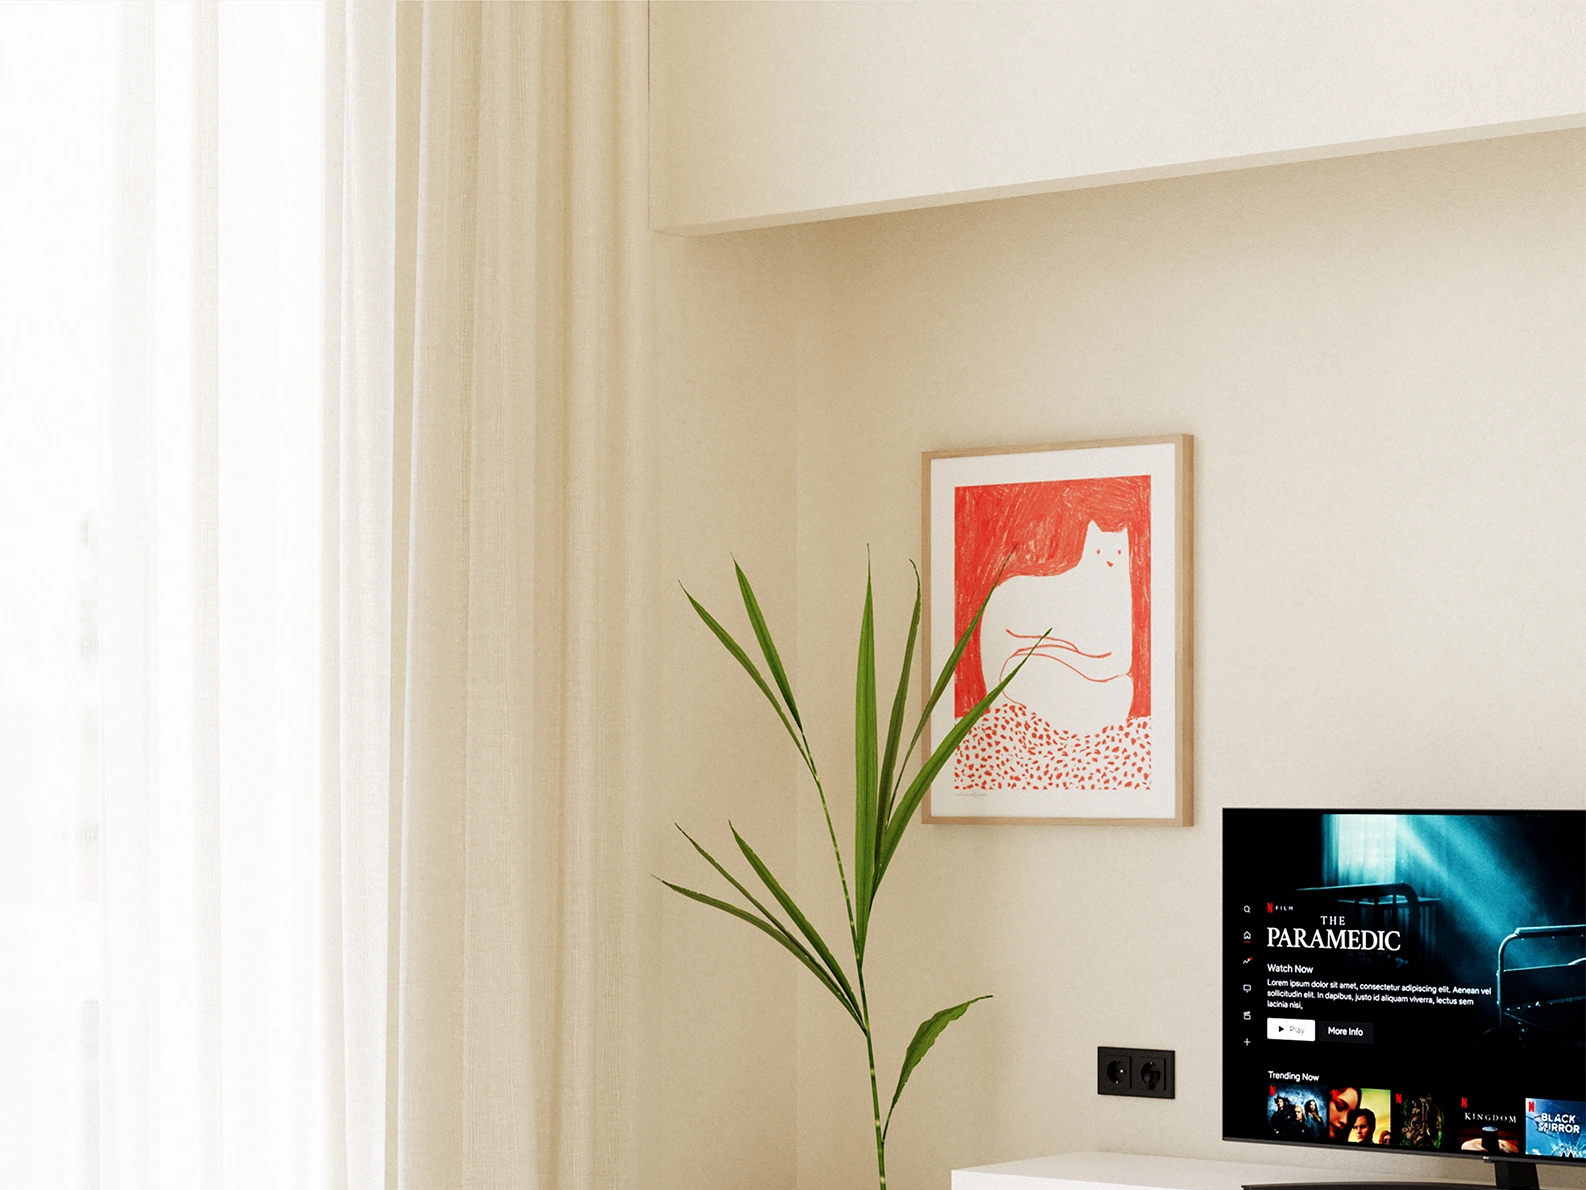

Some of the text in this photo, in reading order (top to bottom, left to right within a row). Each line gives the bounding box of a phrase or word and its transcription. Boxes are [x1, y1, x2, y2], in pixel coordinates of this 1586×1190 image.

[1320, 916, 1345, 925] THE
[1267, 927, 1400, 951] PARAMEDIC
[1267, 964, 1314, 973] Watch Now
[1290, 980, 1310, 988] ipsum
[1339, 982, 1358, 990] amet,
[1359, 983, 1400, 991] consectetur
[1401, 984, 1437, 994] adipiscing
[1452, 986, 1480, 994] Aenean
[1267, 990, 1302, 998] sollicitudin
[1325, 992, 1354, 1001] dapibus,
[1355, 993, 1372, 1002] justo
[1381, 994, 1408, 1003] aliquam
[1409, 996, 1435, 1005] viverra,
[1436, 996, 1457, 1004] lectus
[1267, 1000, 1303, 1010] lacinia nisi,
[1289, 1025, 1305, 1035] Play
[1327, 1026, 1364, 1036] More Info
[1268, 1070, 1319, 1082] Trending Now
[1464, 1112, 1517, 1123] KINGDOM
[1541, 1113, 1576, 1123] BLACK
[1538, 1122, 1580, 1133] MIRROR
